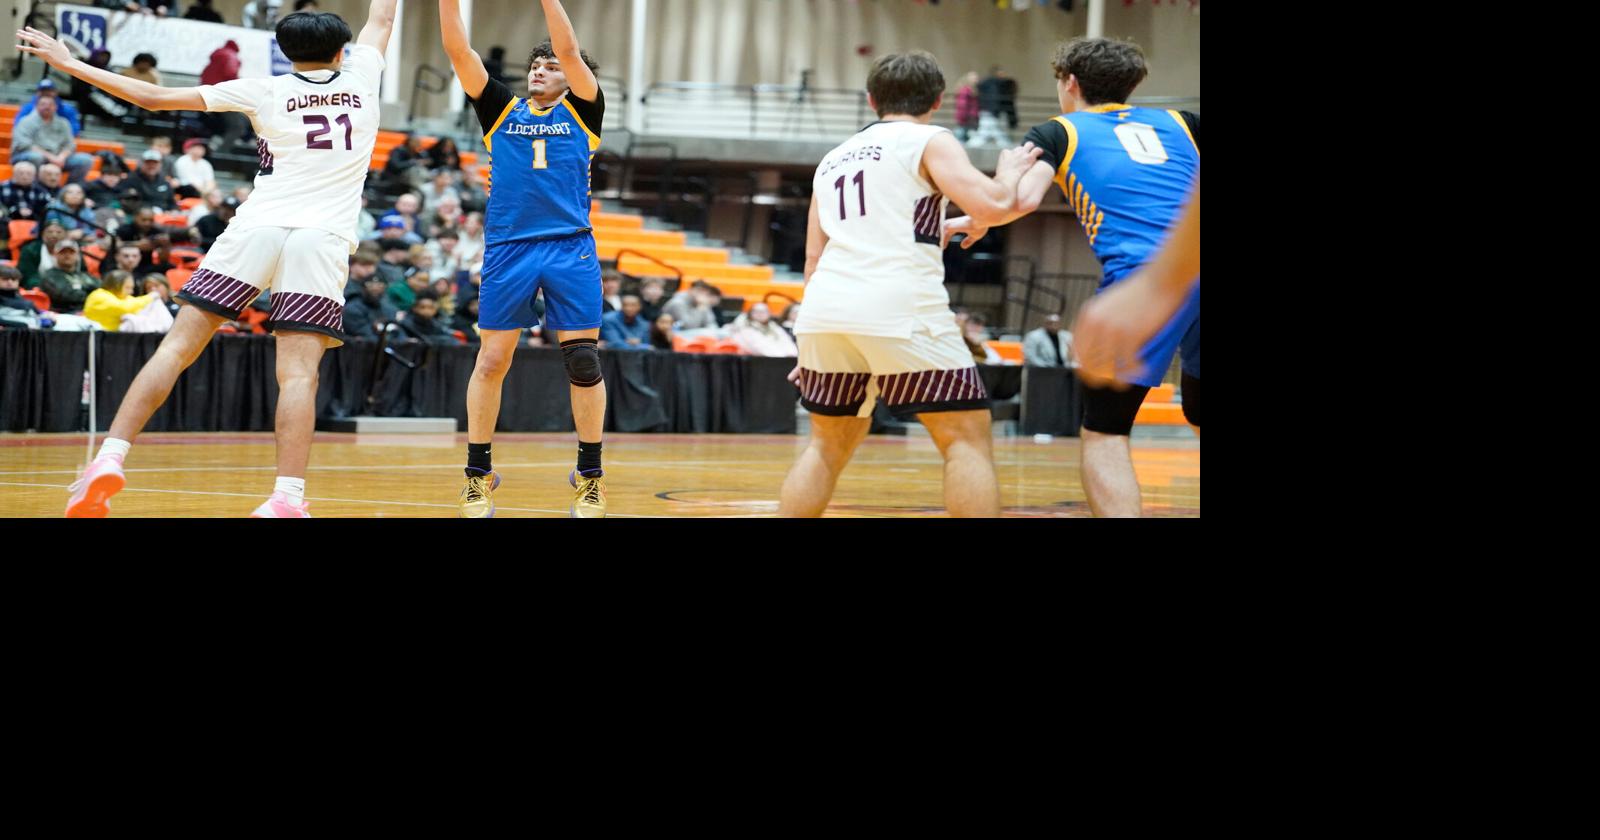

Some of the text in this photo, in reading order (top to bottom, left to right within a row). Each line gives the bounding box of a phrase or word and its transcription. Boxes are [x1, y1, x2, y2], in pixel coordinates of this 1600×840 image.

[287, 93, 361, 112] QUAKERS
[303, 114, 352, 150] 21
[506, 123, 571, 135] LOCKPORT
[1113, 122, 1168, 164] 0
[532, 139, 547, 169] 1
[834, 170, 866, 220] 11
